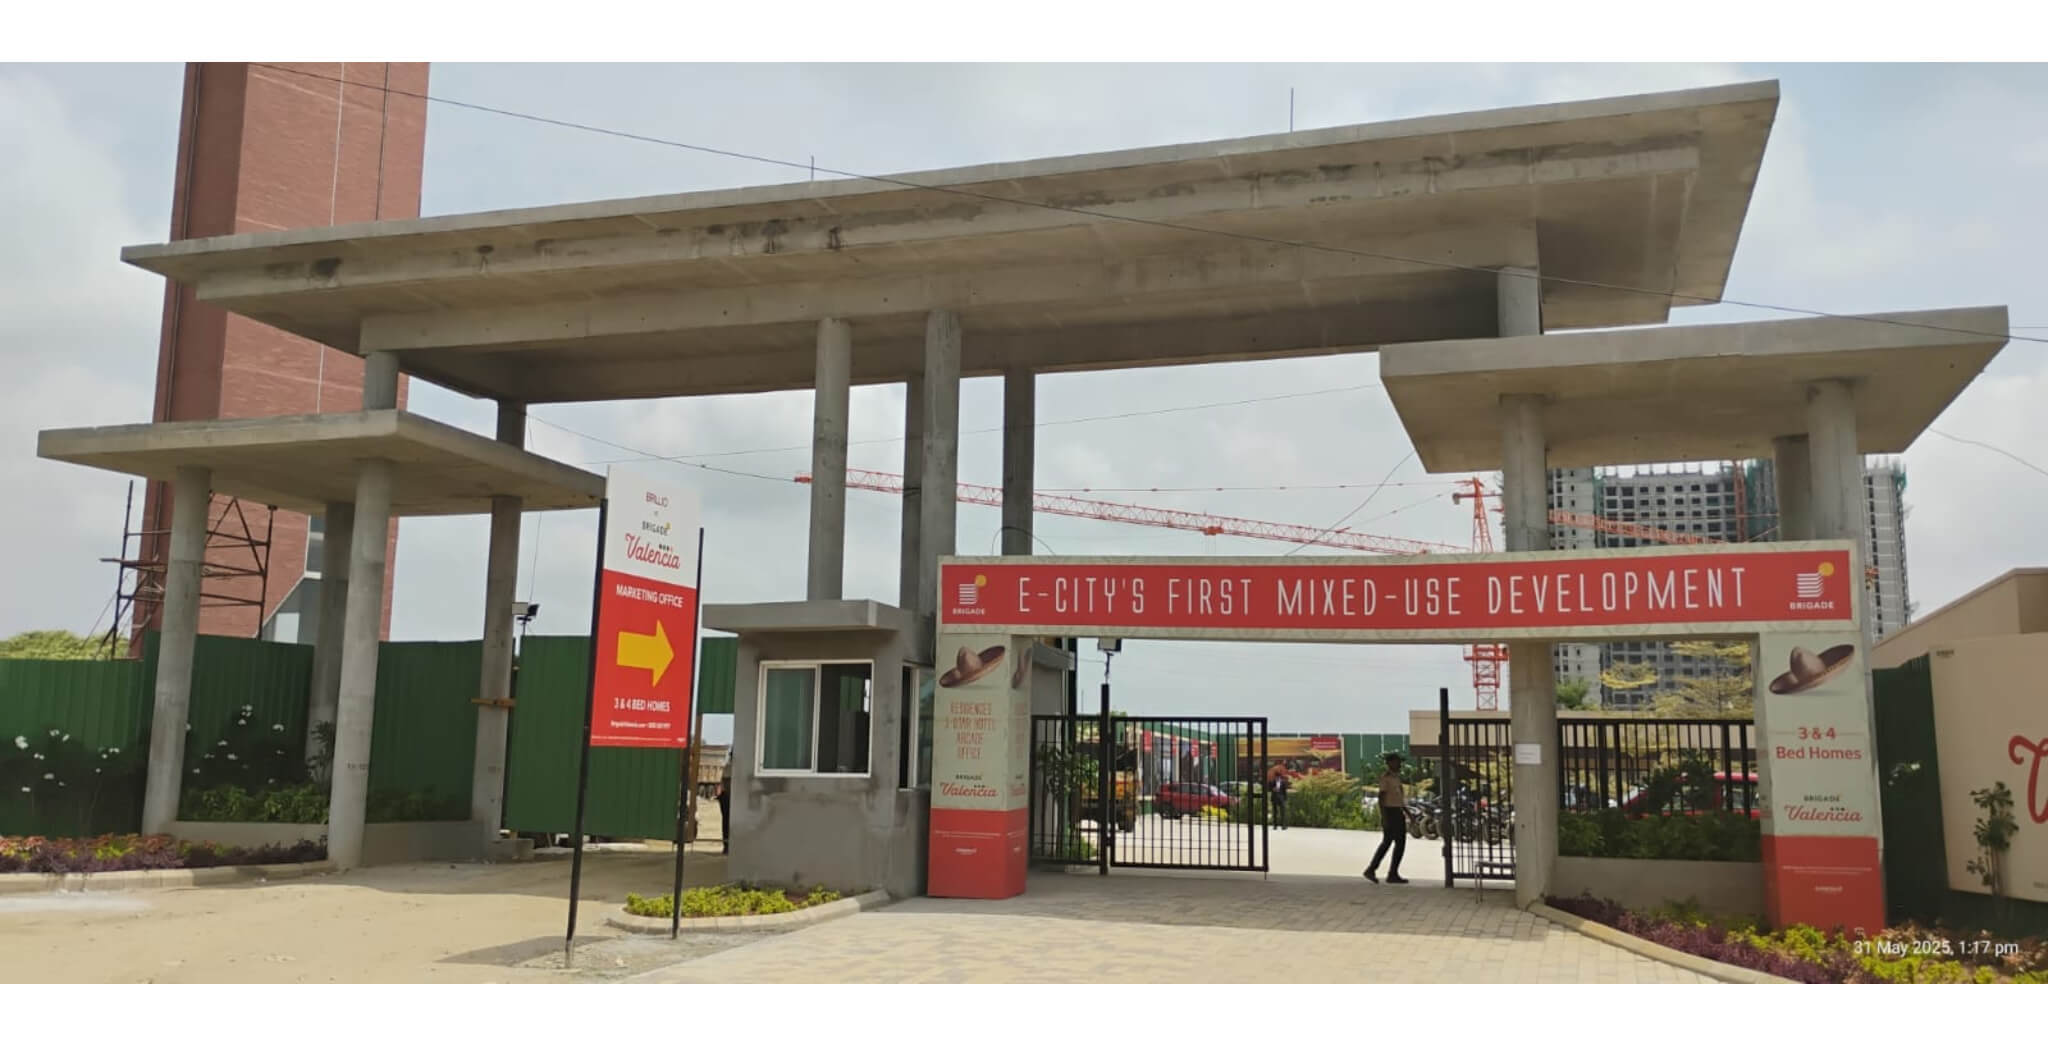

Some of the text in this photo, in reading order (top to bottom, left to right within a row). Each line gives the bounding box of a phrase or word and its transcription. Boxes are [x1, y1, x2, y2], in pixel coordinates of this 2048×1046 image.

[642, 521, 668, 536] BRIGADE
[625, 533, 680, 569] Valencia
[616, 584, 684, 608] MARKETING OFFICE
[1018, 567, 1747, 616] E-CITY'S FIRST MIXED-USE DEVELOPMENT
[1789, 601, 1835, 611] BRIGADE
[632, 698, 646, 711] BED
[647, 700, 670, 712] HOMES
[1798, 727, 1837, 740] 3 & 4
[1776, 746, 1805, 760] Bed
[1809, 747, 1862, 760] Homes
[940, 782, 998, 797] Valencia
[1803, 794, 1840, 802] BRIGADE
[1784, 804, 1863, 822] Valencia
